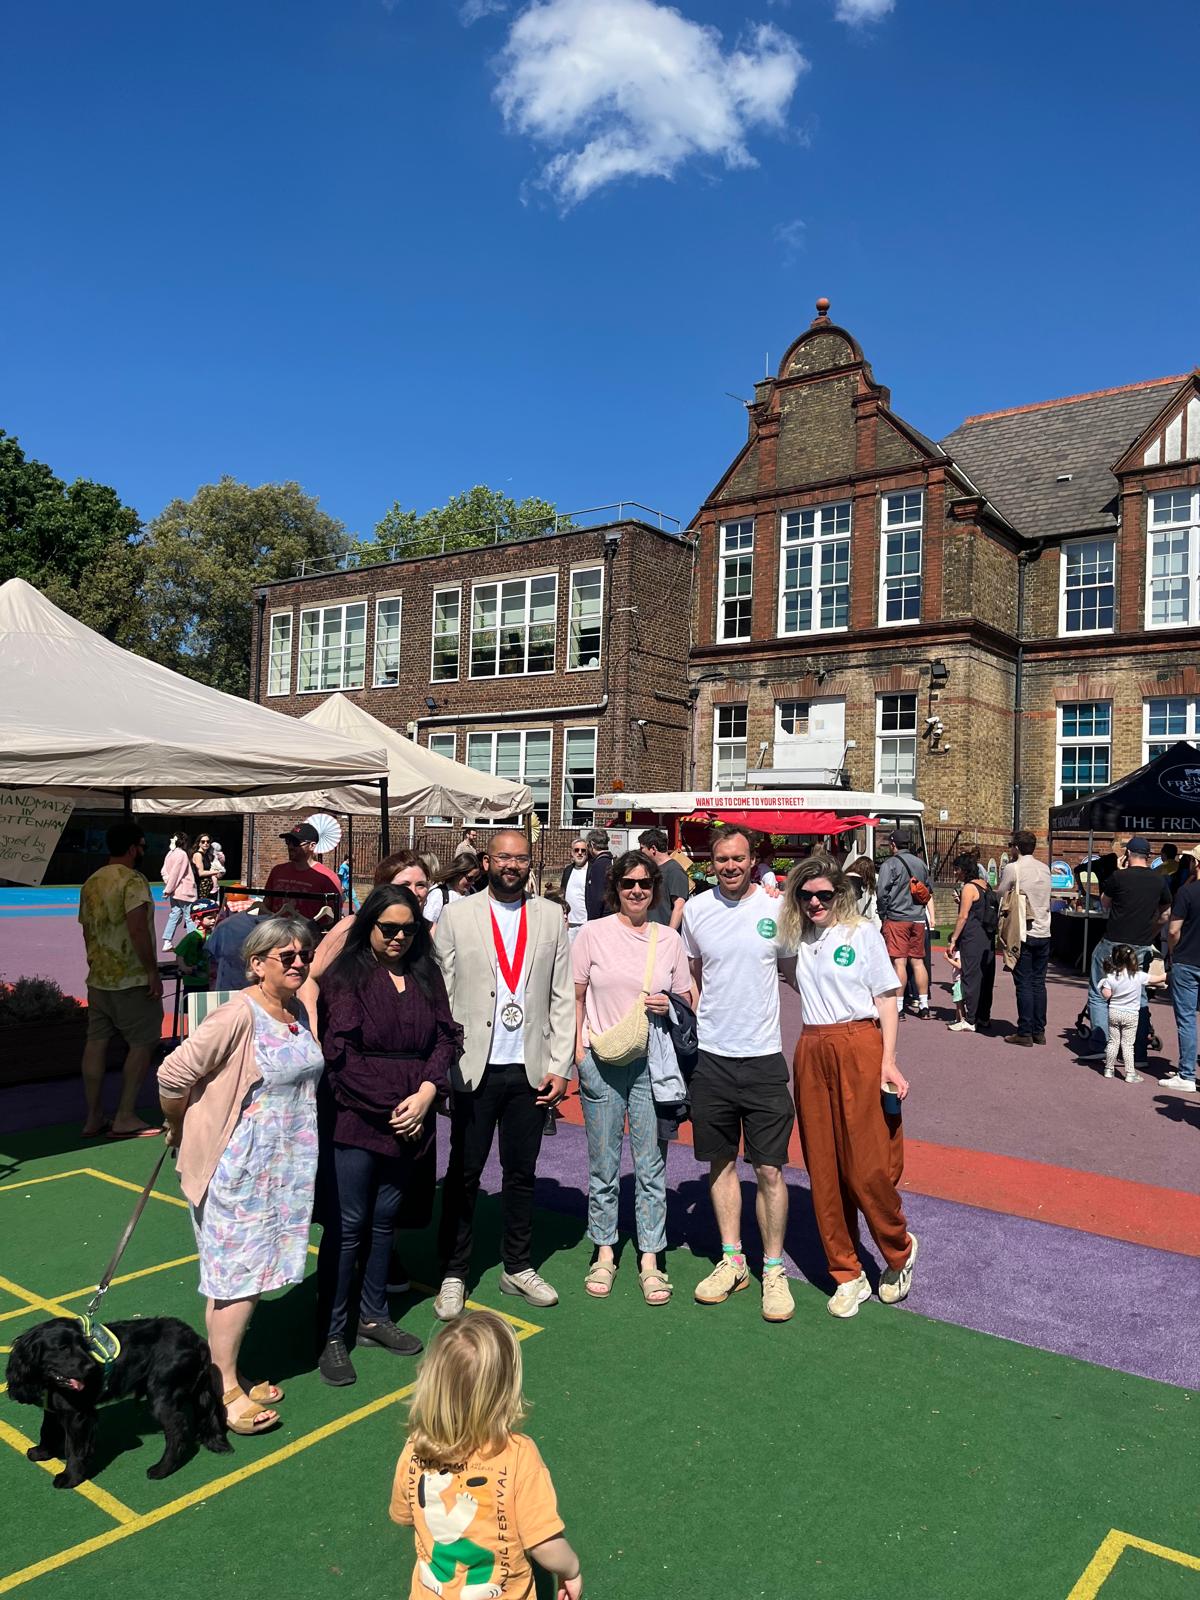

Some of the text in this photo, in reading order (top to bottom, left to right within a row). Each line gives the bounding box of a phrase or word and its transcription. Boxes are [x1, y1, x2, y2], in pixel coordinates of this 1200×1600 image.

[0, 794, 72, 815] HANDMADE
[695, 797, 714, 807] WANT
[714, 797, 724, 807] US
[724, 797, 733, 807] TO
[733, 797, 751, 807] COME
[751, 797, 760, 807] TO
[760, 797, 777, 807] YOUR
[778, 797, 805, 807] STREET?
[22, 808, 34, 816] IN
[1121, 816, 1155, 829] THE
[496, 1465, 508, 1541] FESTIVAL
